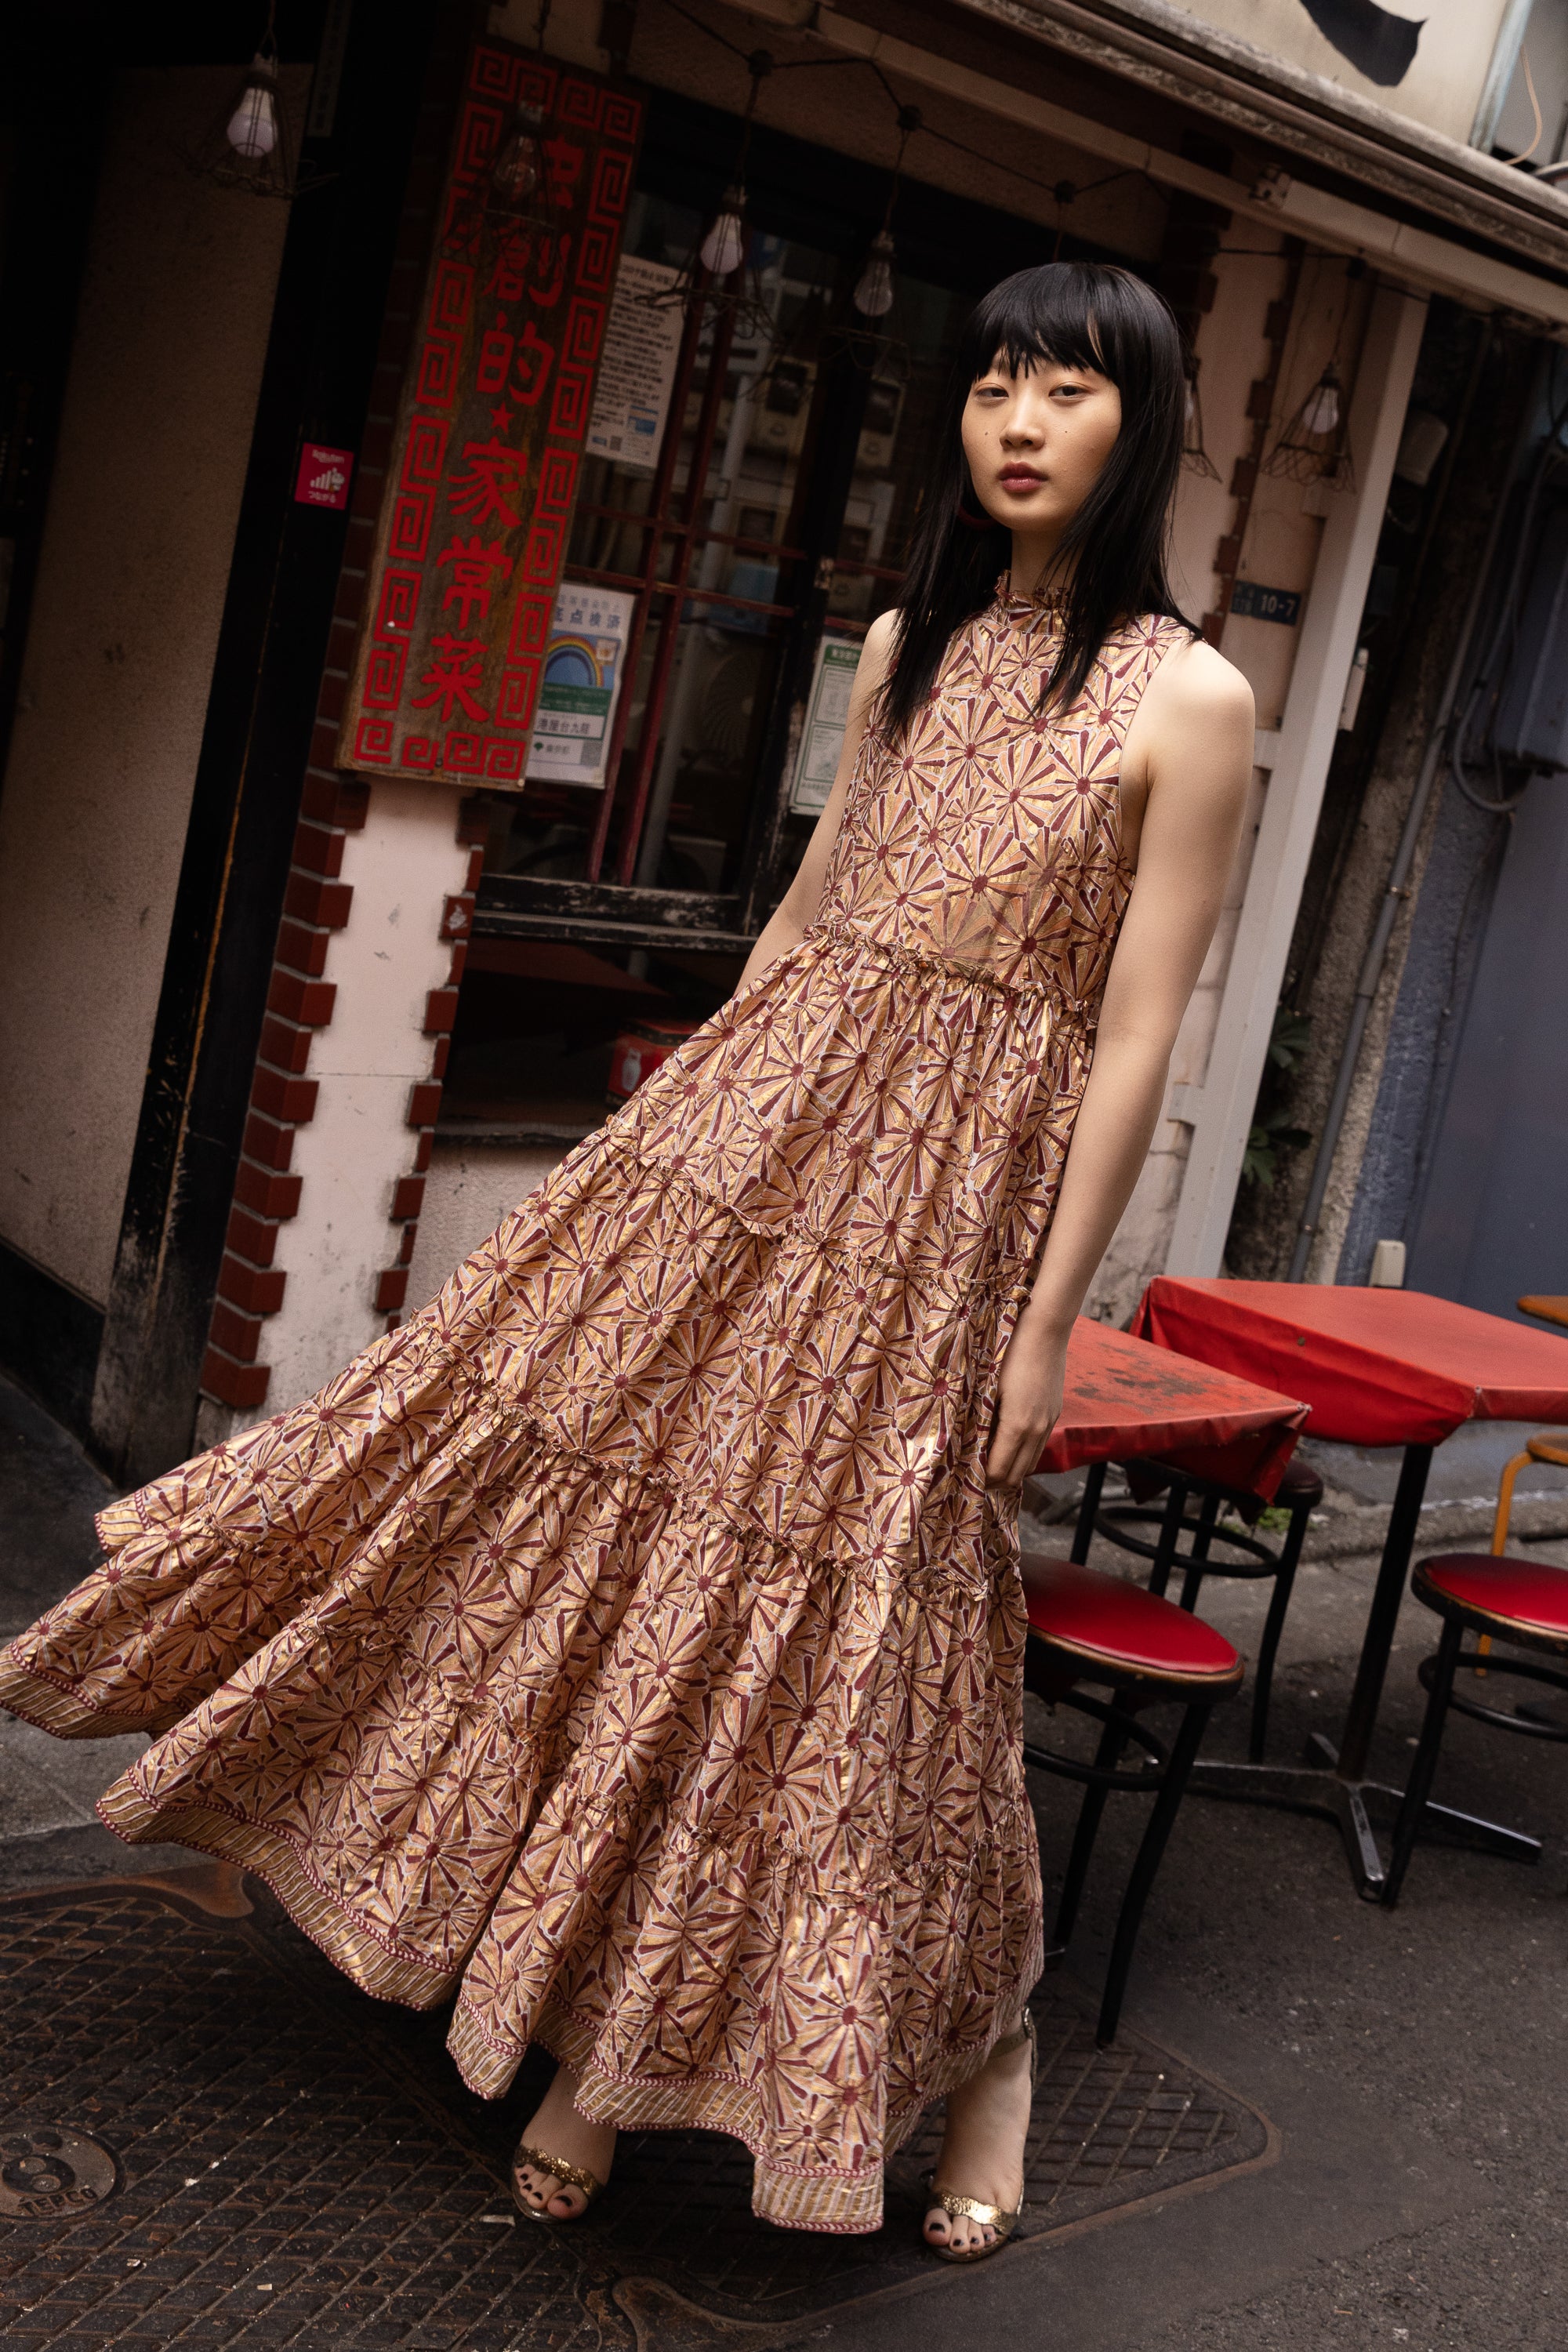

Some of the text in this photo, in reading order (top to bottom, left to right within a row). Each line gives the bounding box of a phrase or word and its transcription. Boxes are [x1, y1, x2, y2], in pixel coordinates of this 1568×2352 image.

[412, 437, 528, 724] 家常菜
[1261, 593, 1297, 618] 10-7
[17, 2188, 98, 2216] TEPCO
